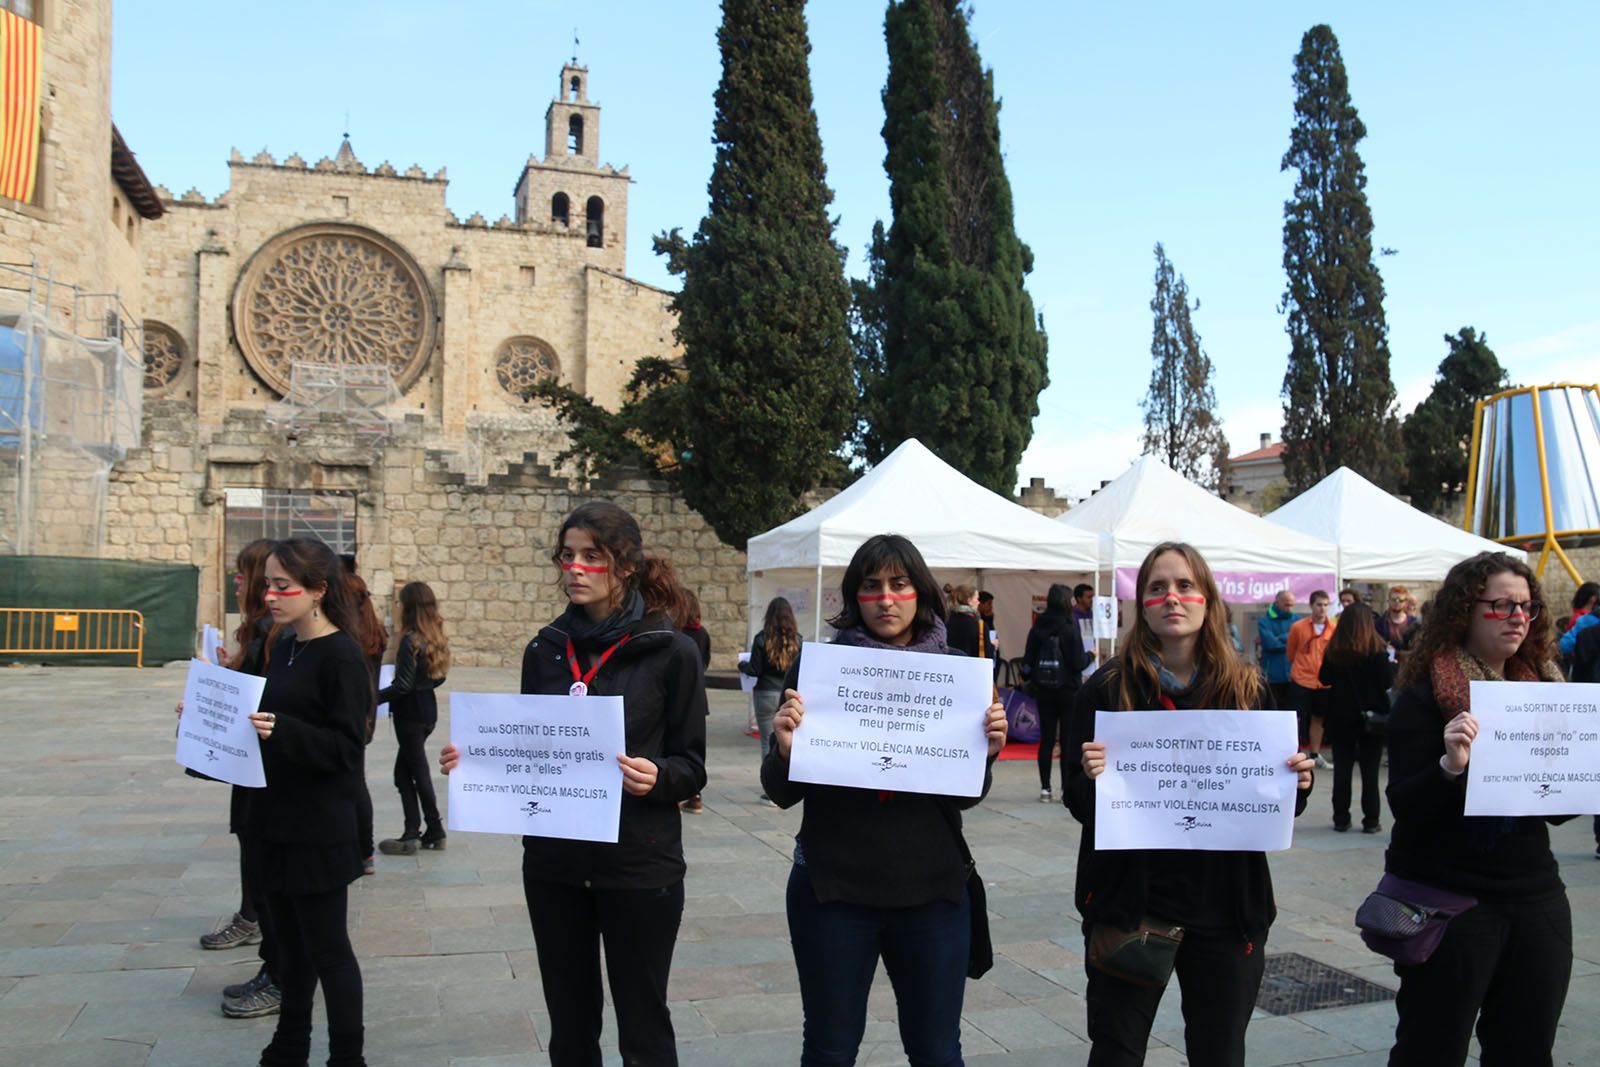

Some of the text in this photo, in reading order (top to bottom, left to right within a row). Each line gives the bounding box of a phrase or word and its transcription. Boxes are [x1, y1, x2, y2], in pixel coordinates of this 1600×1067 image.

[1248, 577, 1290, 599] igual
[840, 667, 954, 684] QUAN SORTINT DE FESTA
[838, 686, 952, 707] Et creus amb dret de
[844, 701, 943, 720] tocar-me sense el
[1523, 703, 1558, 712] SORTINT
[1560, 704, 1571, 713] DE
[1573, 704, 1597, 713] FESTA
[478, 723, 590, 737] QUAN SORTINT DE FESTA
[859, 718, 925, 732] meu permís
[1494, 730, 1507, 741] No
[1510, 731, 1540, 742] entens
[1543, 731, 1554, 742] un
[1579, 733, 1598, 741] com
[810, 738, 831, 747] ESTIC
[833, 740, 858, 749] PATINT
[915, 746, 969, 759] MASCLISTA
[1130, 738, 1262, 752] QUAN SORTINT DE FESTA
[1530, 745, 1569, 758] resposta
[468, 745, 604, 763] Les discoteques són gratis
[506, 763, 522, 775] per
[525, 765, 531, 773] a
[1116, 760, 1274, 779] Les discoteques són gratis
[463, 784, 484, 792] ESTIC
[485, 785, 509, 793] PATINT
[559, 787, 608, 800] MASCLISTA
[1158, 779, 1177, 791] per
[1180, 780, 1187, 789] a
[1112, 801, 1132, 809] ESTIC
[1221, 801, 1280, 813] MASCLISTA
